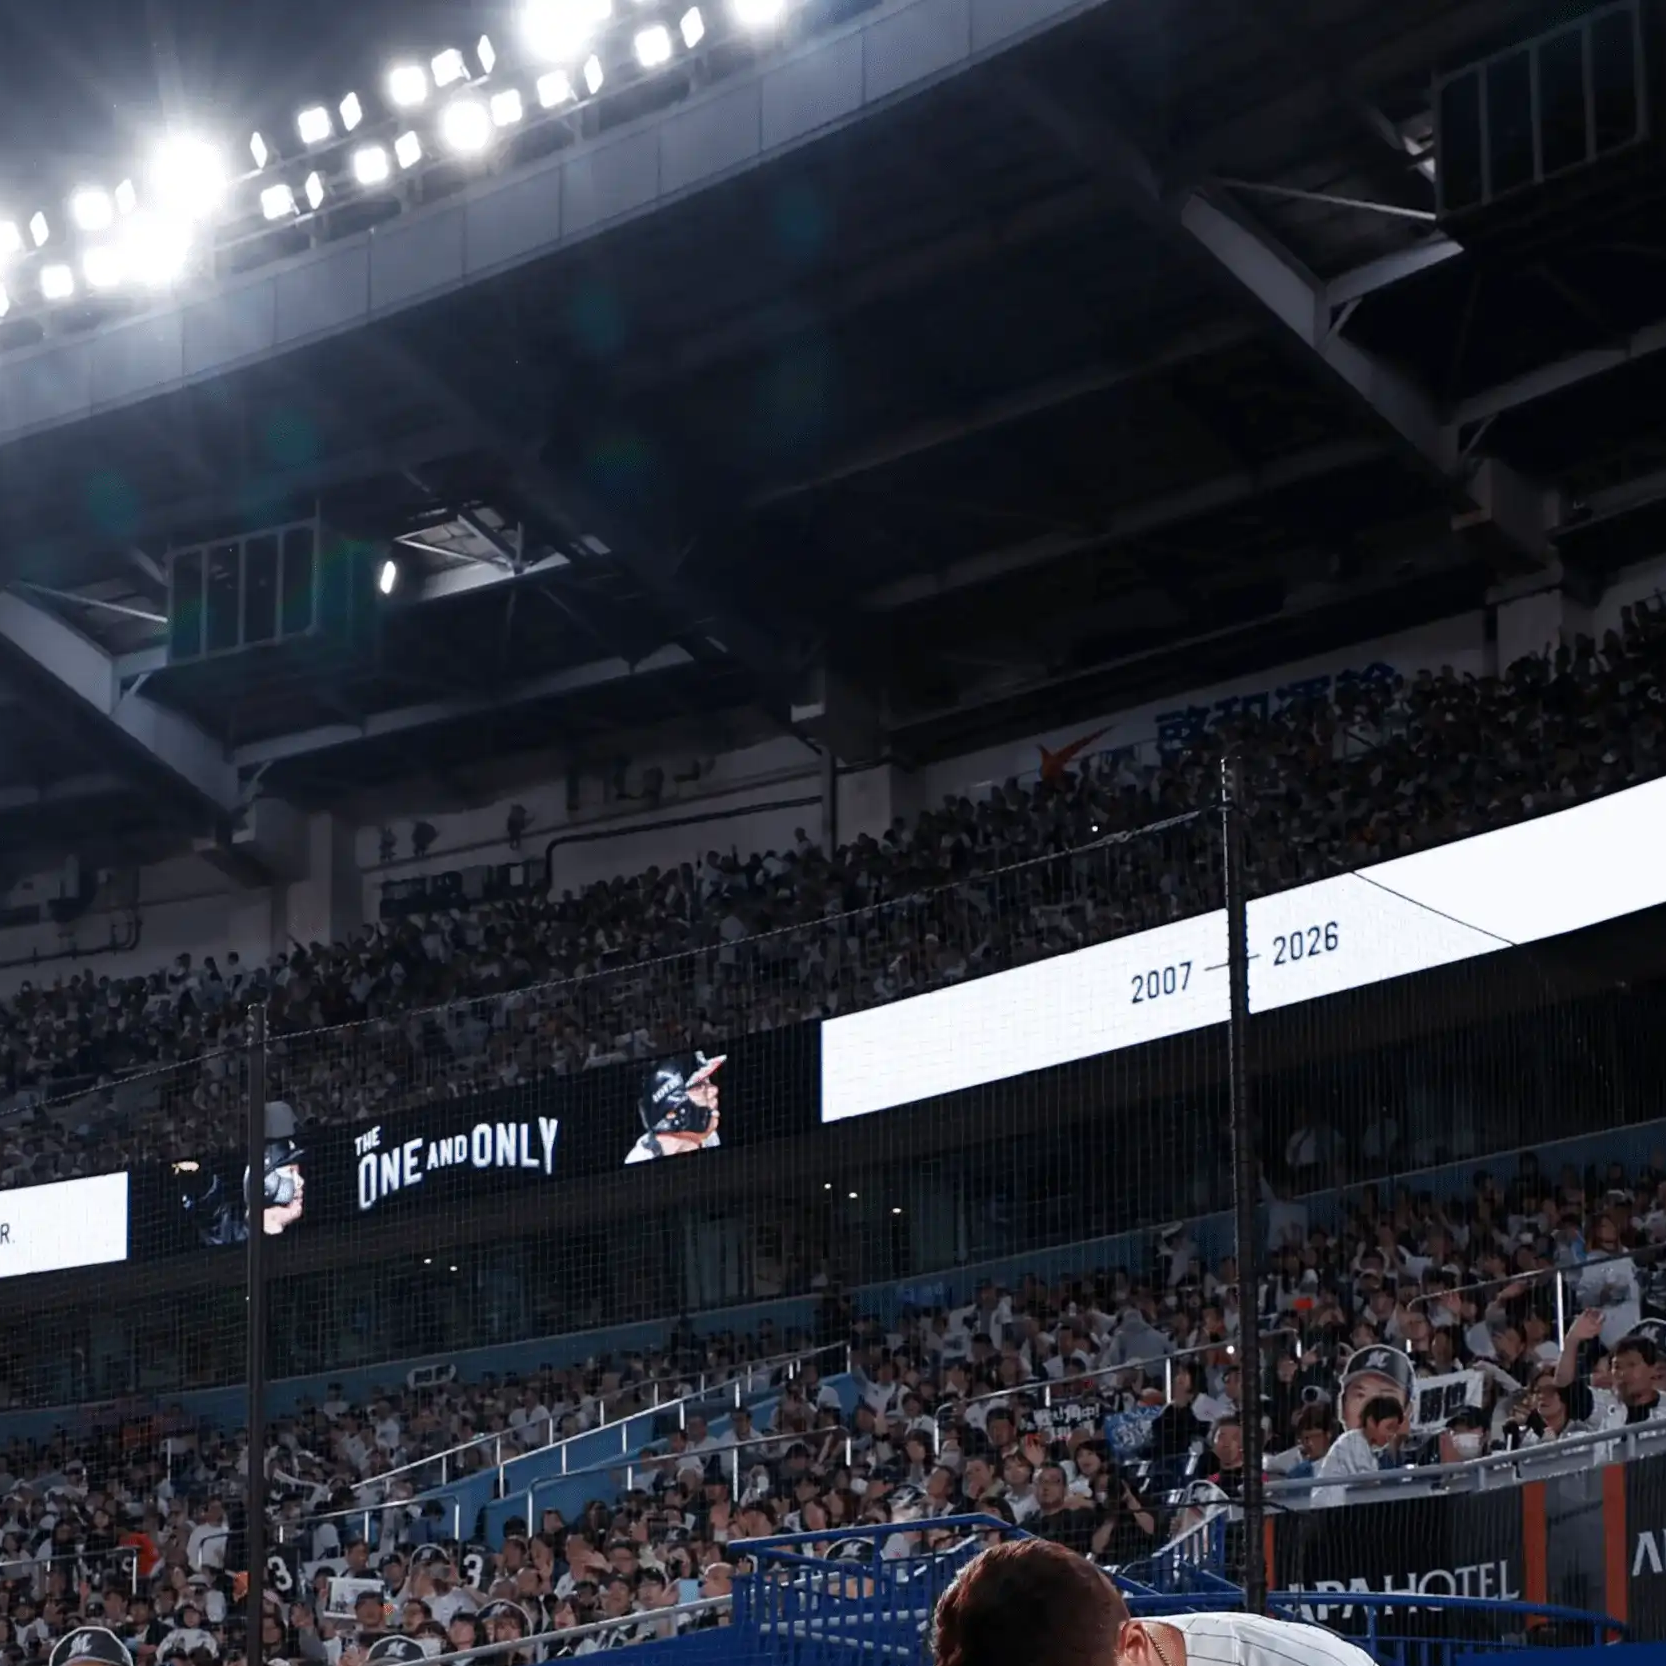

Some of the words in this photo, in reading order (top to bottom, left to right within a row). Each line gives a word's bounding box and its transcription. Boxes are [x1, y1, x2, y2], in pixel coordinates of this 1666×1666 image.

[1131, 961, 1193, 1004] 2007
[1272, 922, 1340, 967] 2026
[354, 1126, 381, 1157] THE
[358, 1138, 423, 1210] ONE
[426, 1135, 468, 1171] AND
[471, 1117, 559, 1175] ONLY
[463, 1553, 484, 1590] 3
[1385, 1559, 1520, 1617] HOTEL
